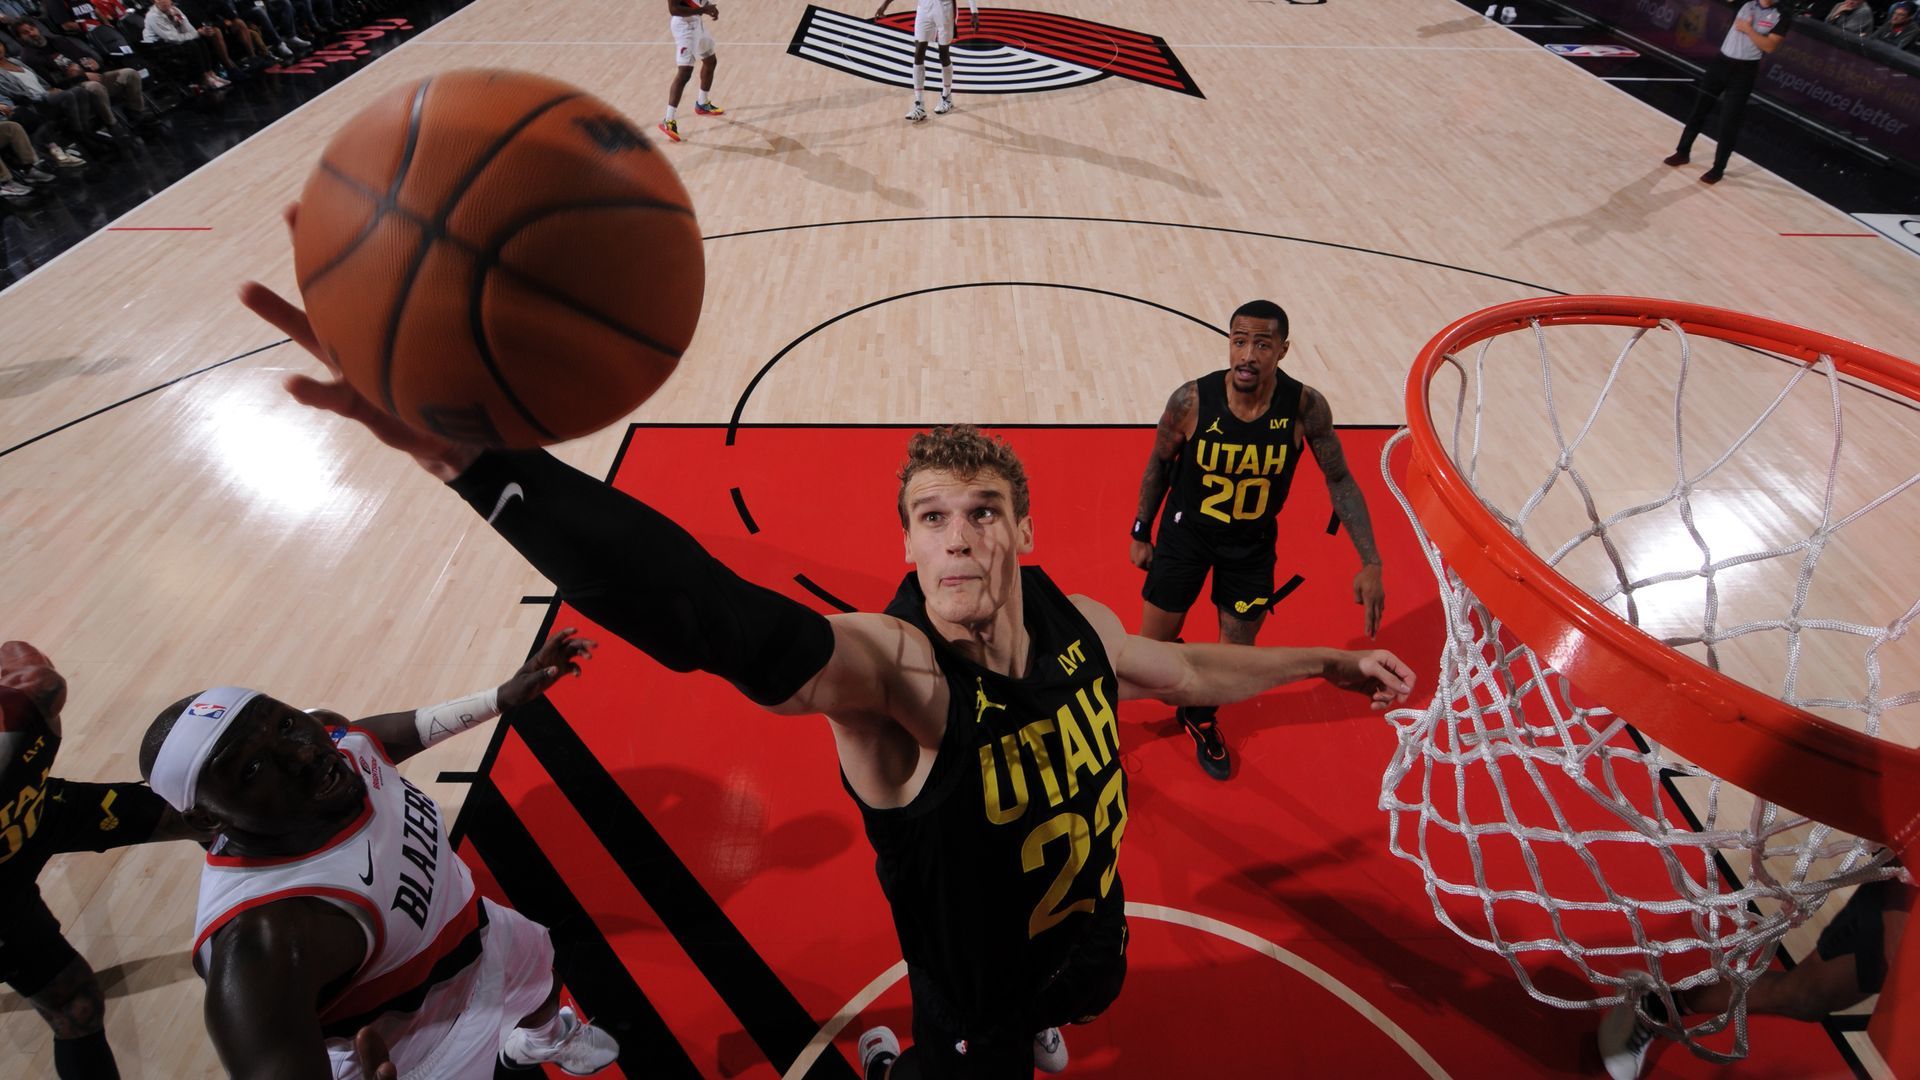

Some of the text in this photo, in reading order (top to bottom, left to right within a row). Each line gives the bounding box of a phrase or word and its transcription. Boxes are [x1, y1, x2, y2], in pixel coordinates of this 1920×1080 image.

[1766, 63, 1909, 135] Experience better
[1270, 418, 1289, 430] LVT
[1196, 439, 1287, 475] UTAH
[1200, 474, 1271, 524] 20
[1057, 639, 1085, 676] LVT
[979, 676, 1120, 825] UTAH
[391, 776, 438, 931] BLAZERS
[1021, 768, 1128, 940] 23
